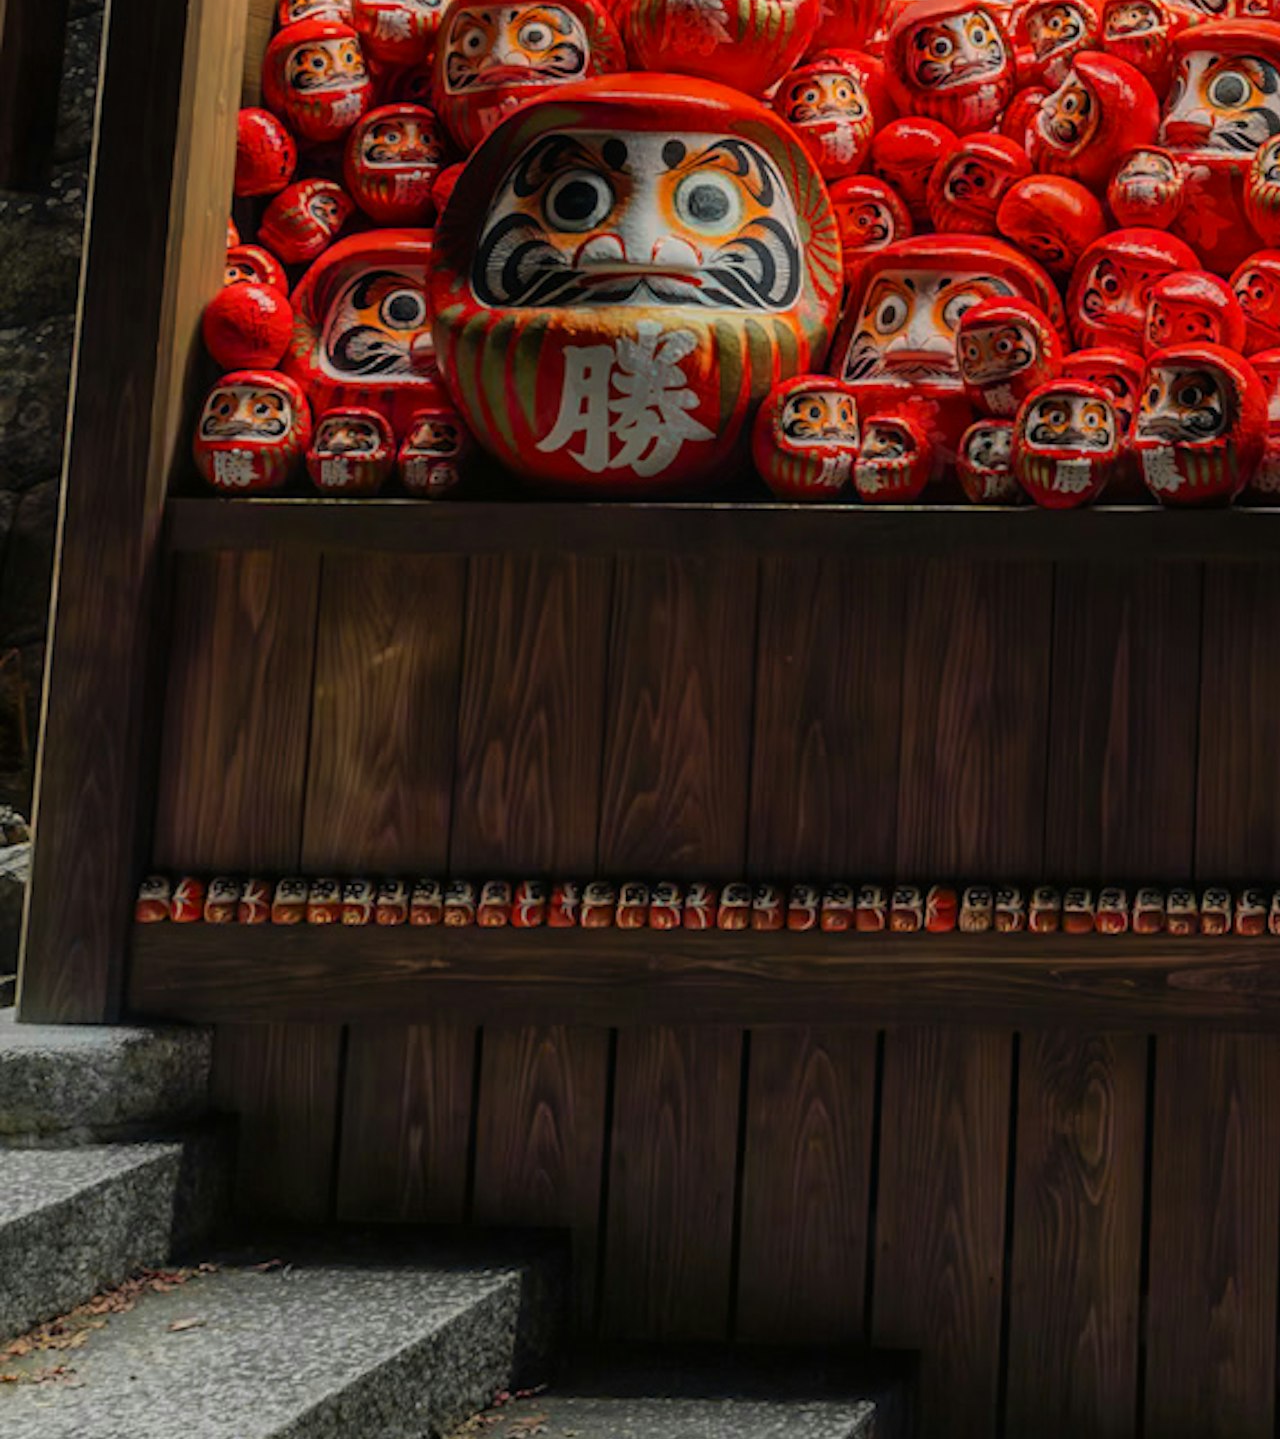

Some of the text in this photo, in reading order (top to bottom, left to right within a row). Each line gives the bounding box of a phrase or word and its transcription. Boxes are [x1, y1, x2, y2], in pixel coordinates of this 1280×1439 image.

[538, 323, 712, 477] 勝
[213, 448, 260, 485] 勝
[1055, 462, 1092, 493] 勝
[1143, 447, 1186, 492] 勝
